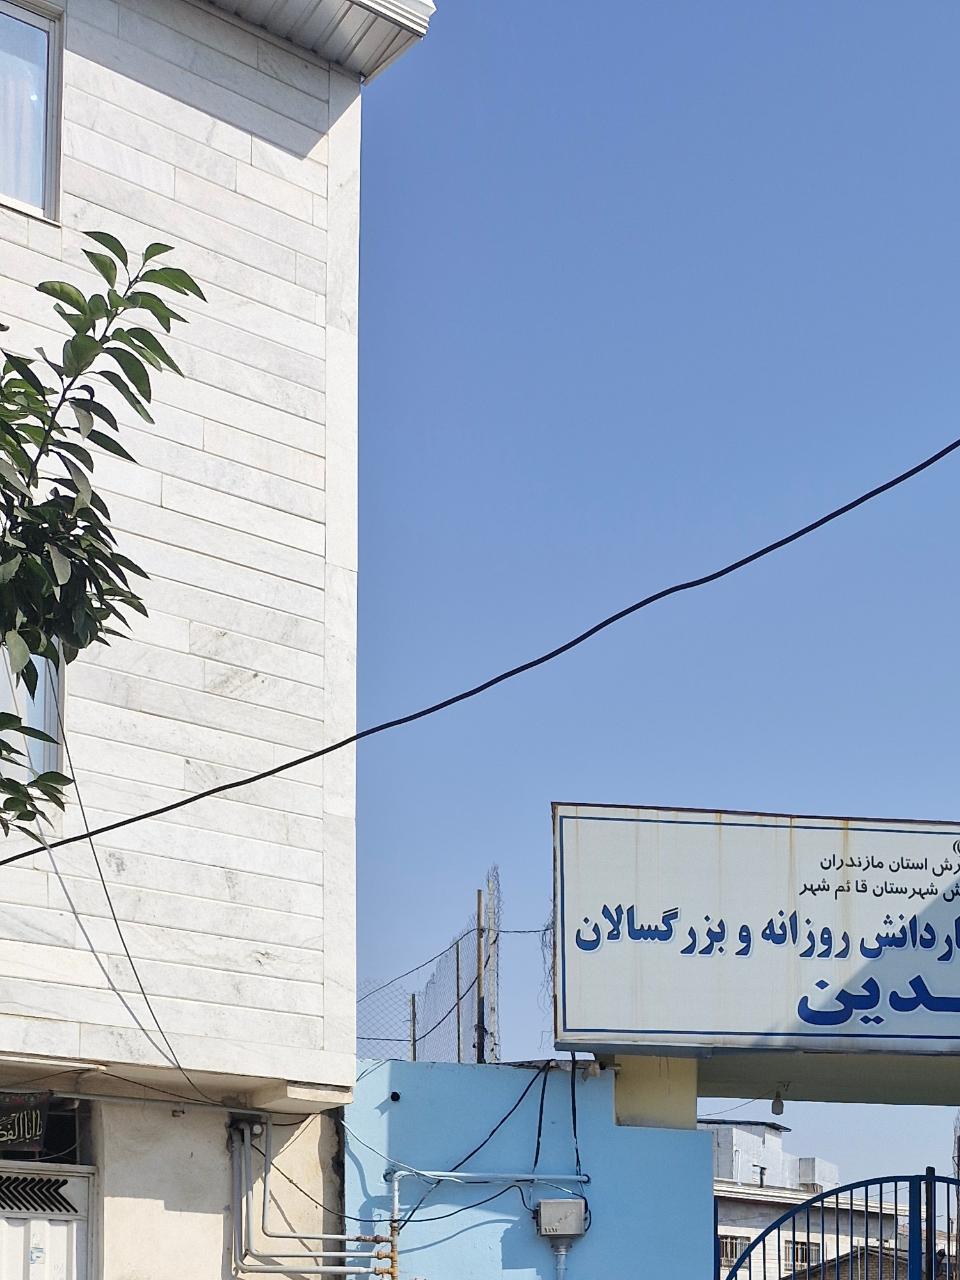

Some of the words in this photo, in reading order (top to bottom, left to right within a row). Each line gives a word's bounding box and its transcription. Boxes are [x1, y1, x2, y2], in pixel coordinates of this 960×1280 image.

[820, 854, 884, 872] مازندران
[888, 857, 928, 872] استان
[872, 881, 939, 899] شهرستان
[575, 904, 727, 955] بزرگسالان
[734, 924, 753, 955] و
[761, 910, 850, 958] روزانه
